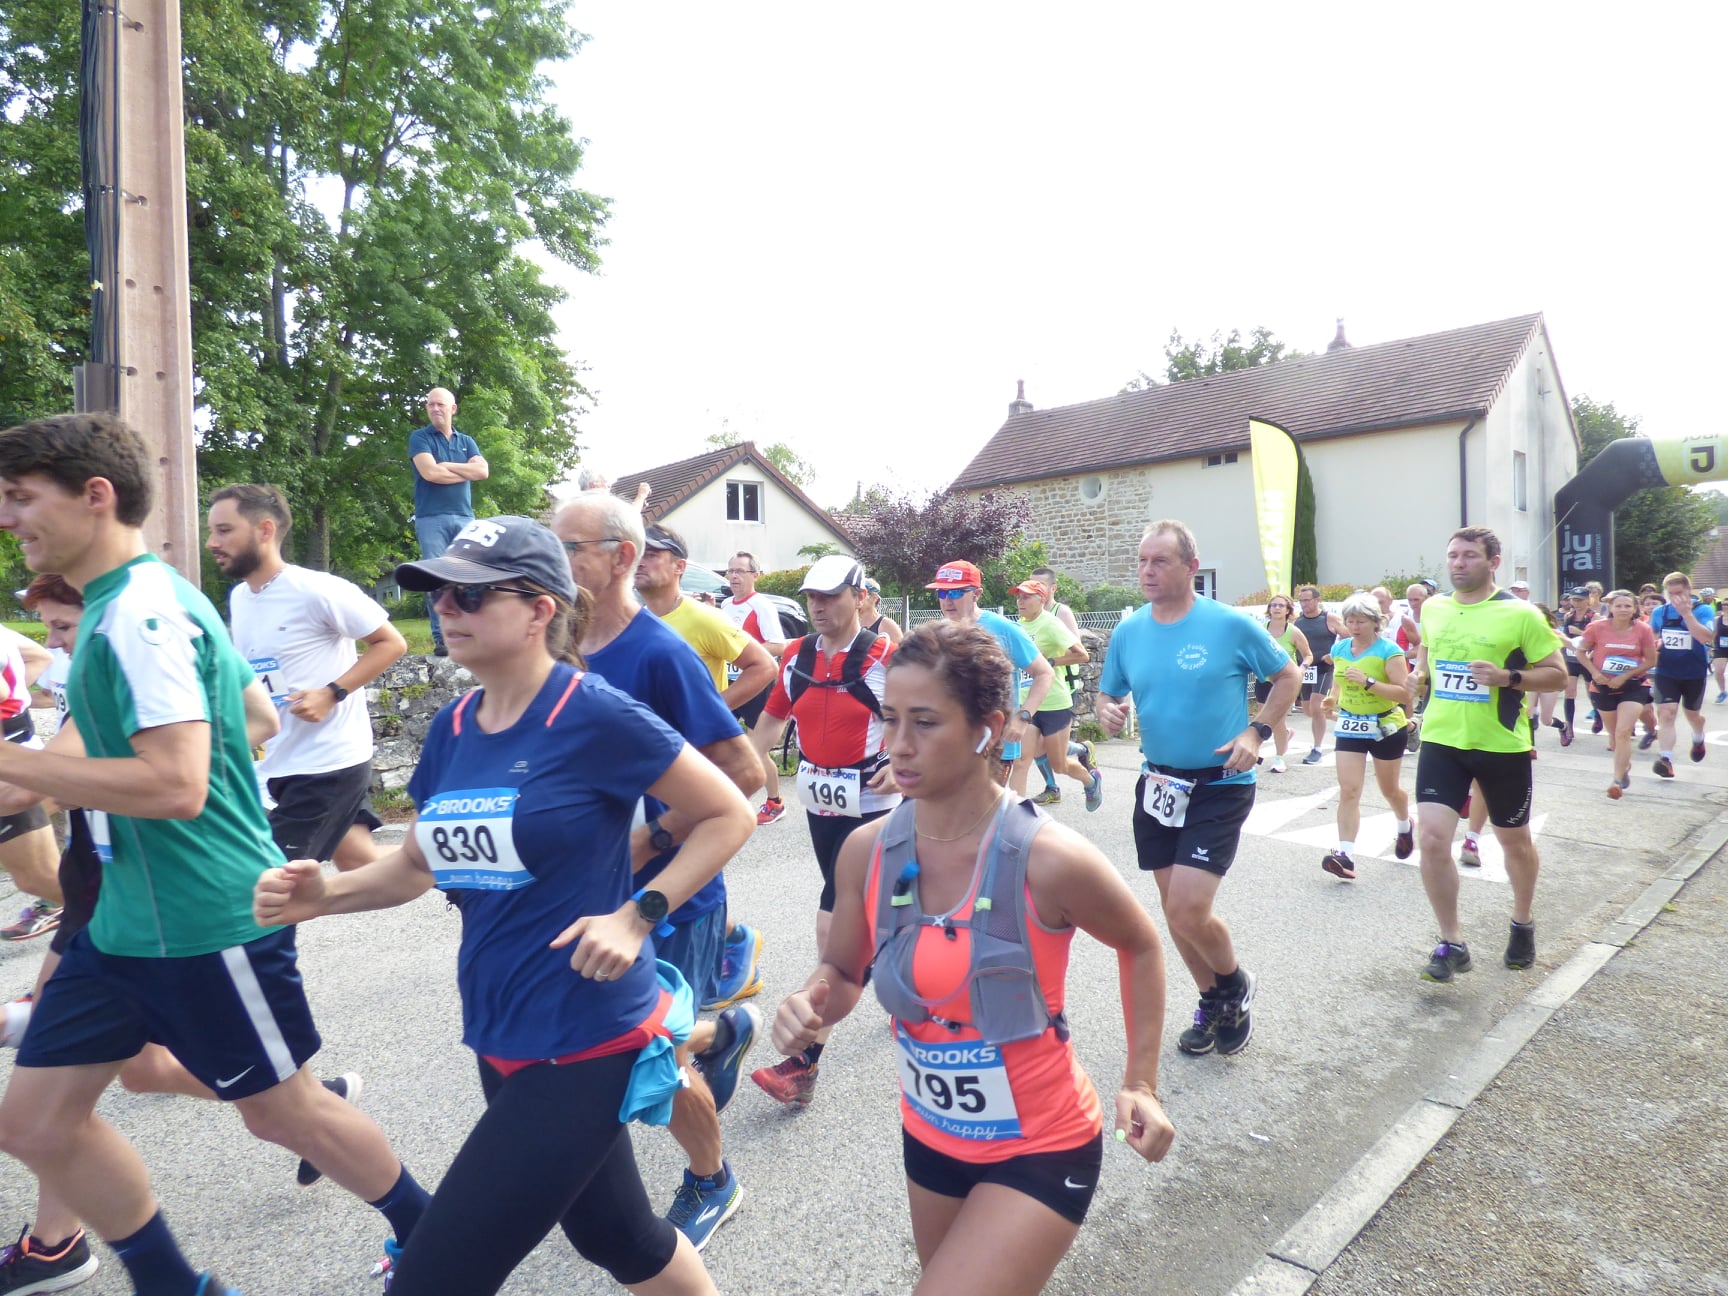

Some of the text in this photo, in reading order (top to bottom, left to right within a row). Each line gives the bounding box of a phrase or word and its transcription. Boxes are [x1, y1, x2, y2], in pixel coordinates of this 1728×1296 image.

[1665, 636, 1684, 647] 221
[1442, 672, 1479, 691] 775
[1341, 719, 1369, 732] 826
[436, 796, 513, 815] BROOKS
[808, 781, 847, 810] 196
[1152, 784, 1176, 818] 218
[432, 825, 498, 864] 830
[906, 1058, 988, 1114] 795
[940, 1120, 998, 1140] happy
